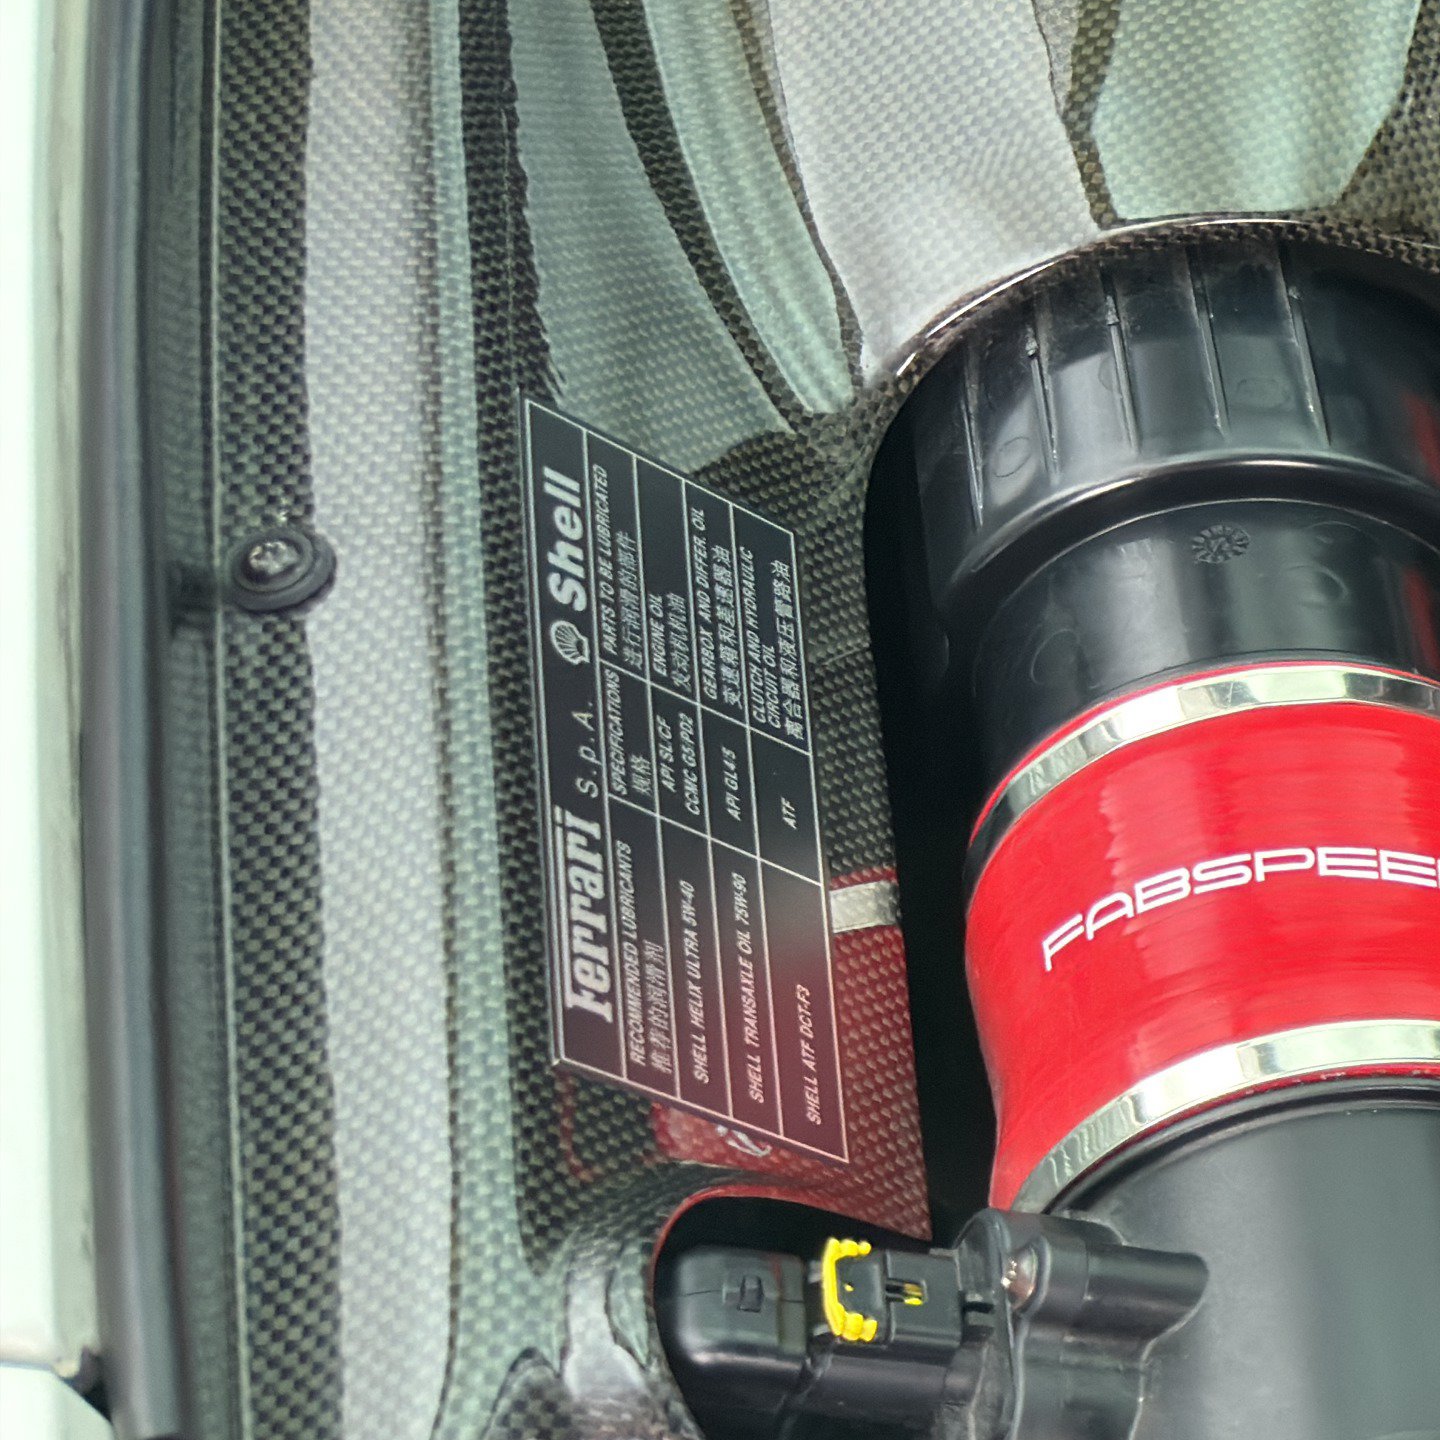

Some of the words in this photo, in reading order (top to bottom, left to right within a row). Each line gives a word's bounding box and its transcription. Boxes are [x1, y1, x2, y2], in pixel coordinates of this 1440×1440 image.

[592, 464, 612, 556] LUBRICATED
[691, 507, 706, 531] OIL
[543, 466, 587, 611] Shell
[598, 559, 612, 580] BE
[599, 582, 614, 602] TO
[740, 546, 758, 629] HYDRAULIC
[600, 604, 617, 655] PARTS
[648, 593, 663, 618] OIL
[696, 592, 712, 622] AND
[650, 618, 667, 677] ENGINE
[699, 626, 718, 700] GEARBOX
[746, 630, 762, 663] AND
[762, 644, 776, 667] OIL
[748, 662, 766, 723] CLUTCH
[764, 668, 782, 728] CIRCUIT
[604, 668, 628, 796] SPECIFICATIONS
[630, 754, 652, 796] 规格
[660, 766, 676, 792] API
[683, 770, 700, 815] CCMC
[725, 794, 741, 820] API
[780, 797, 797, 829] ATF
[555, 806, 613, 1022] Ferrari
[616, 840, 637, 939] LUBRICANTS
[680, 880, 698, 926] 5W-40
[732, 872, 750, 926] 75W-90
[684, 928, 700, 979] ULTRA
[736, 930, 752, 955] OIL
[623, 942, 646, 1066] RECOMMENDED
[687, 982, 706, 1029] HELIX
[739, 959, 760, 1048] TRANSAXLE
[796, 983, 814, 1039] DCT-F3
[690, 1034, 710, 1084] SHELL
[746, 1055, 764, 1104] SHELL
[801, 1040, 816, 1072] ATF
[804, 1077, 822, 1125] SHELL
